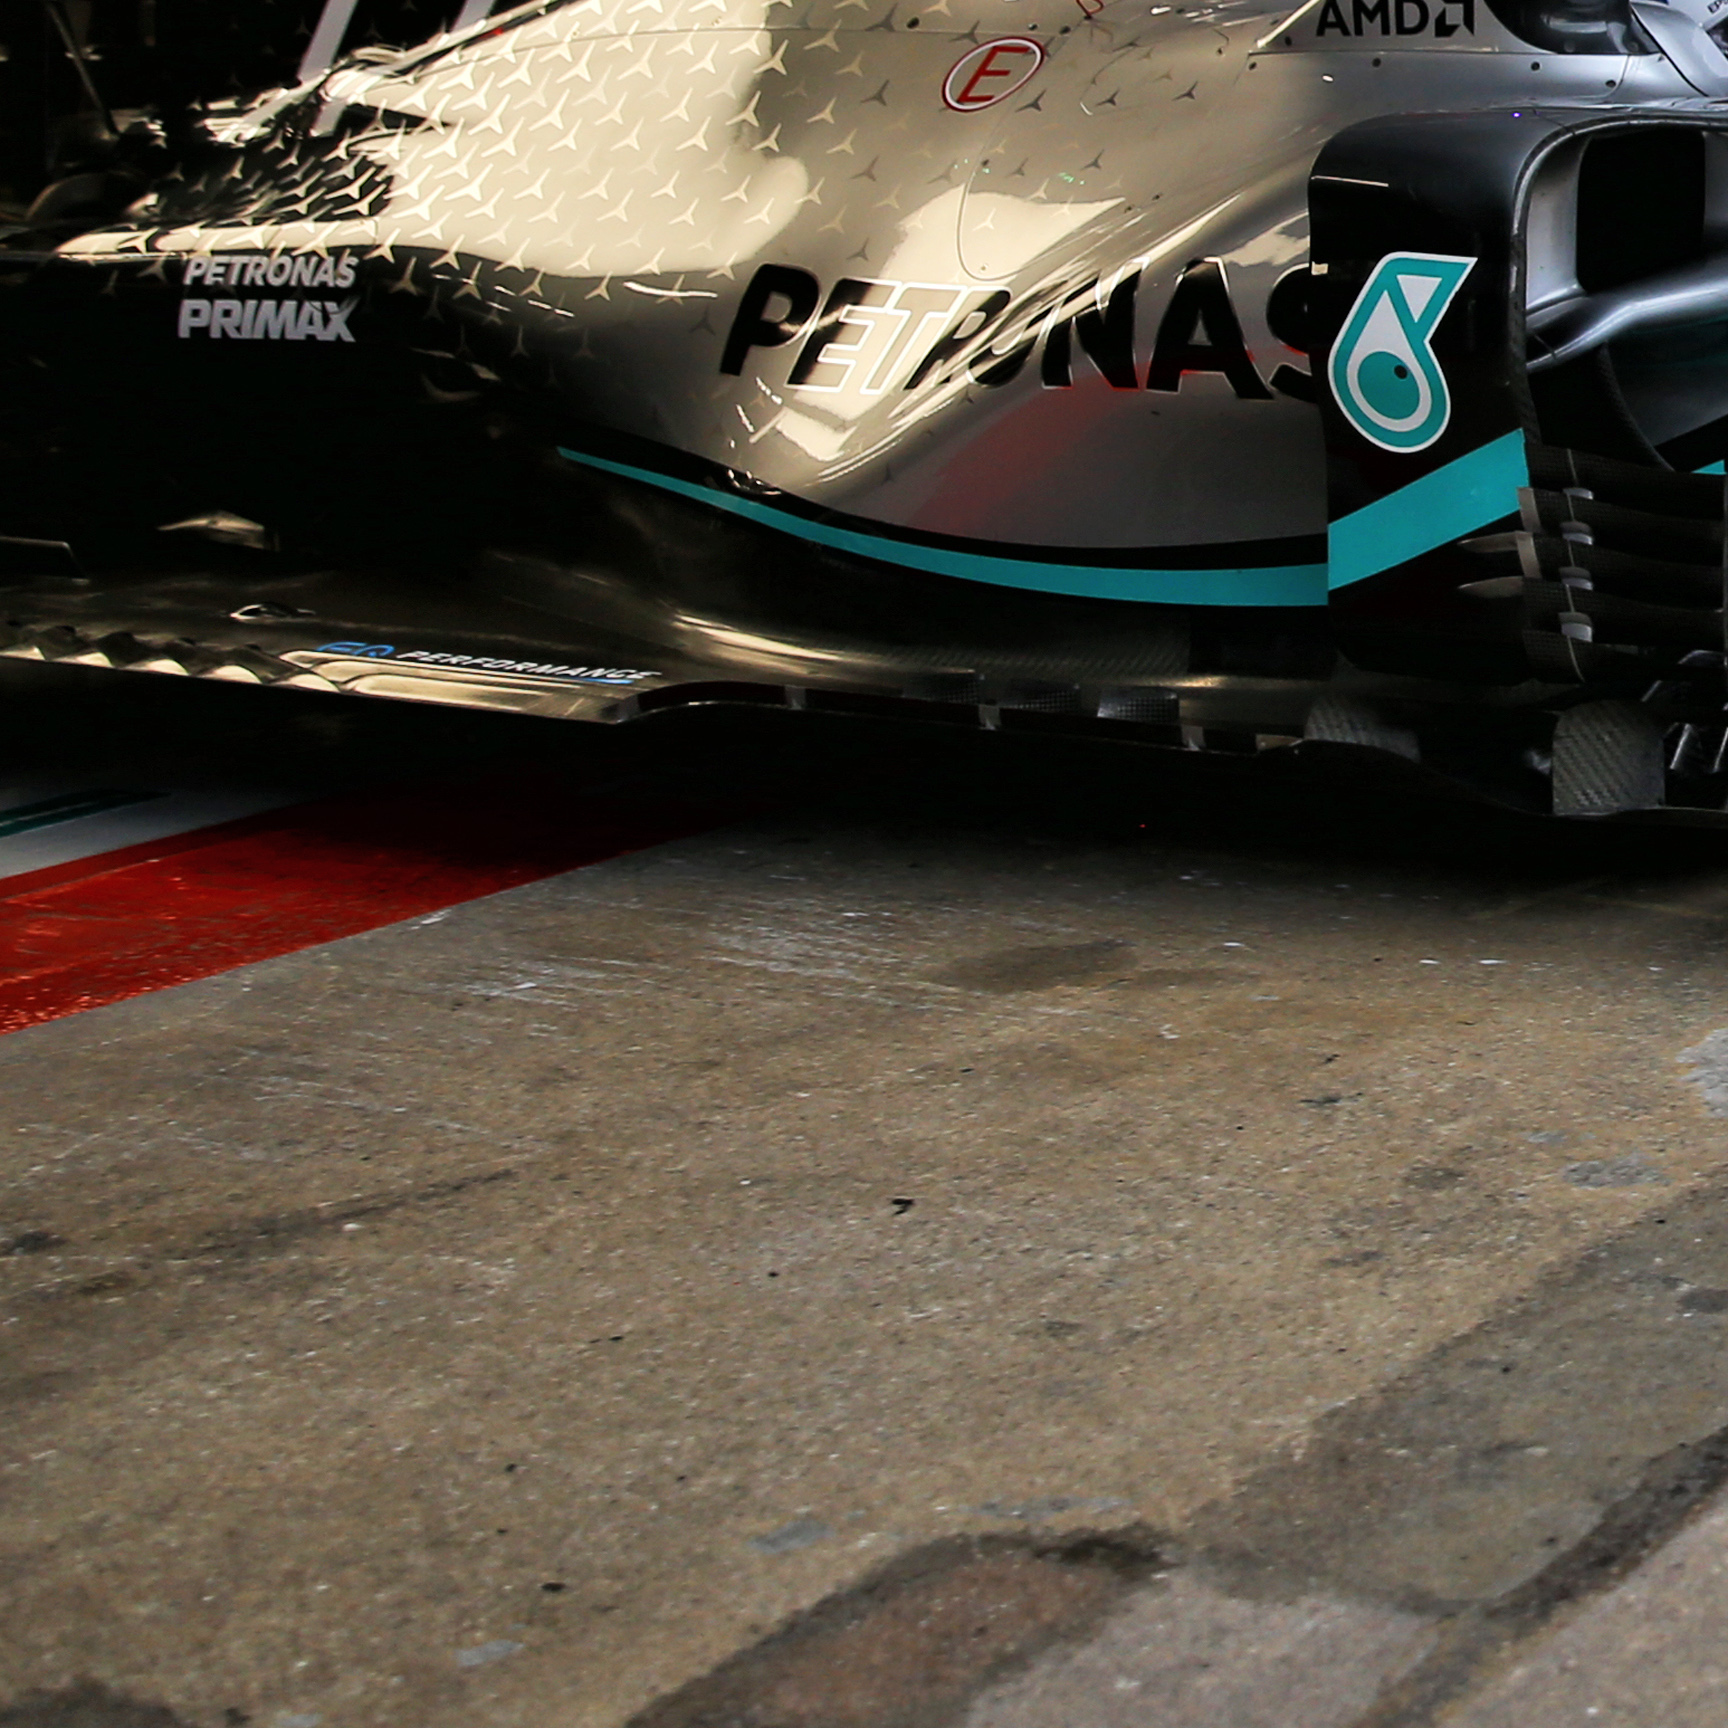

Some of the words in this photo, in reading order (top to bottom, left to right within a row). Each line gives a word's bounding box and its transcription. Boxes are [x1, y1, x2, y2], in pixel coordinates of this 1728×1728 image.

[183, 255, 357, 290] PETRONAS
[178, 298, 356, 343] PRIMAX
[719, 257, 1311, 402] PETRONAS
[396, 649, 663, 680] PERFORMANCE
